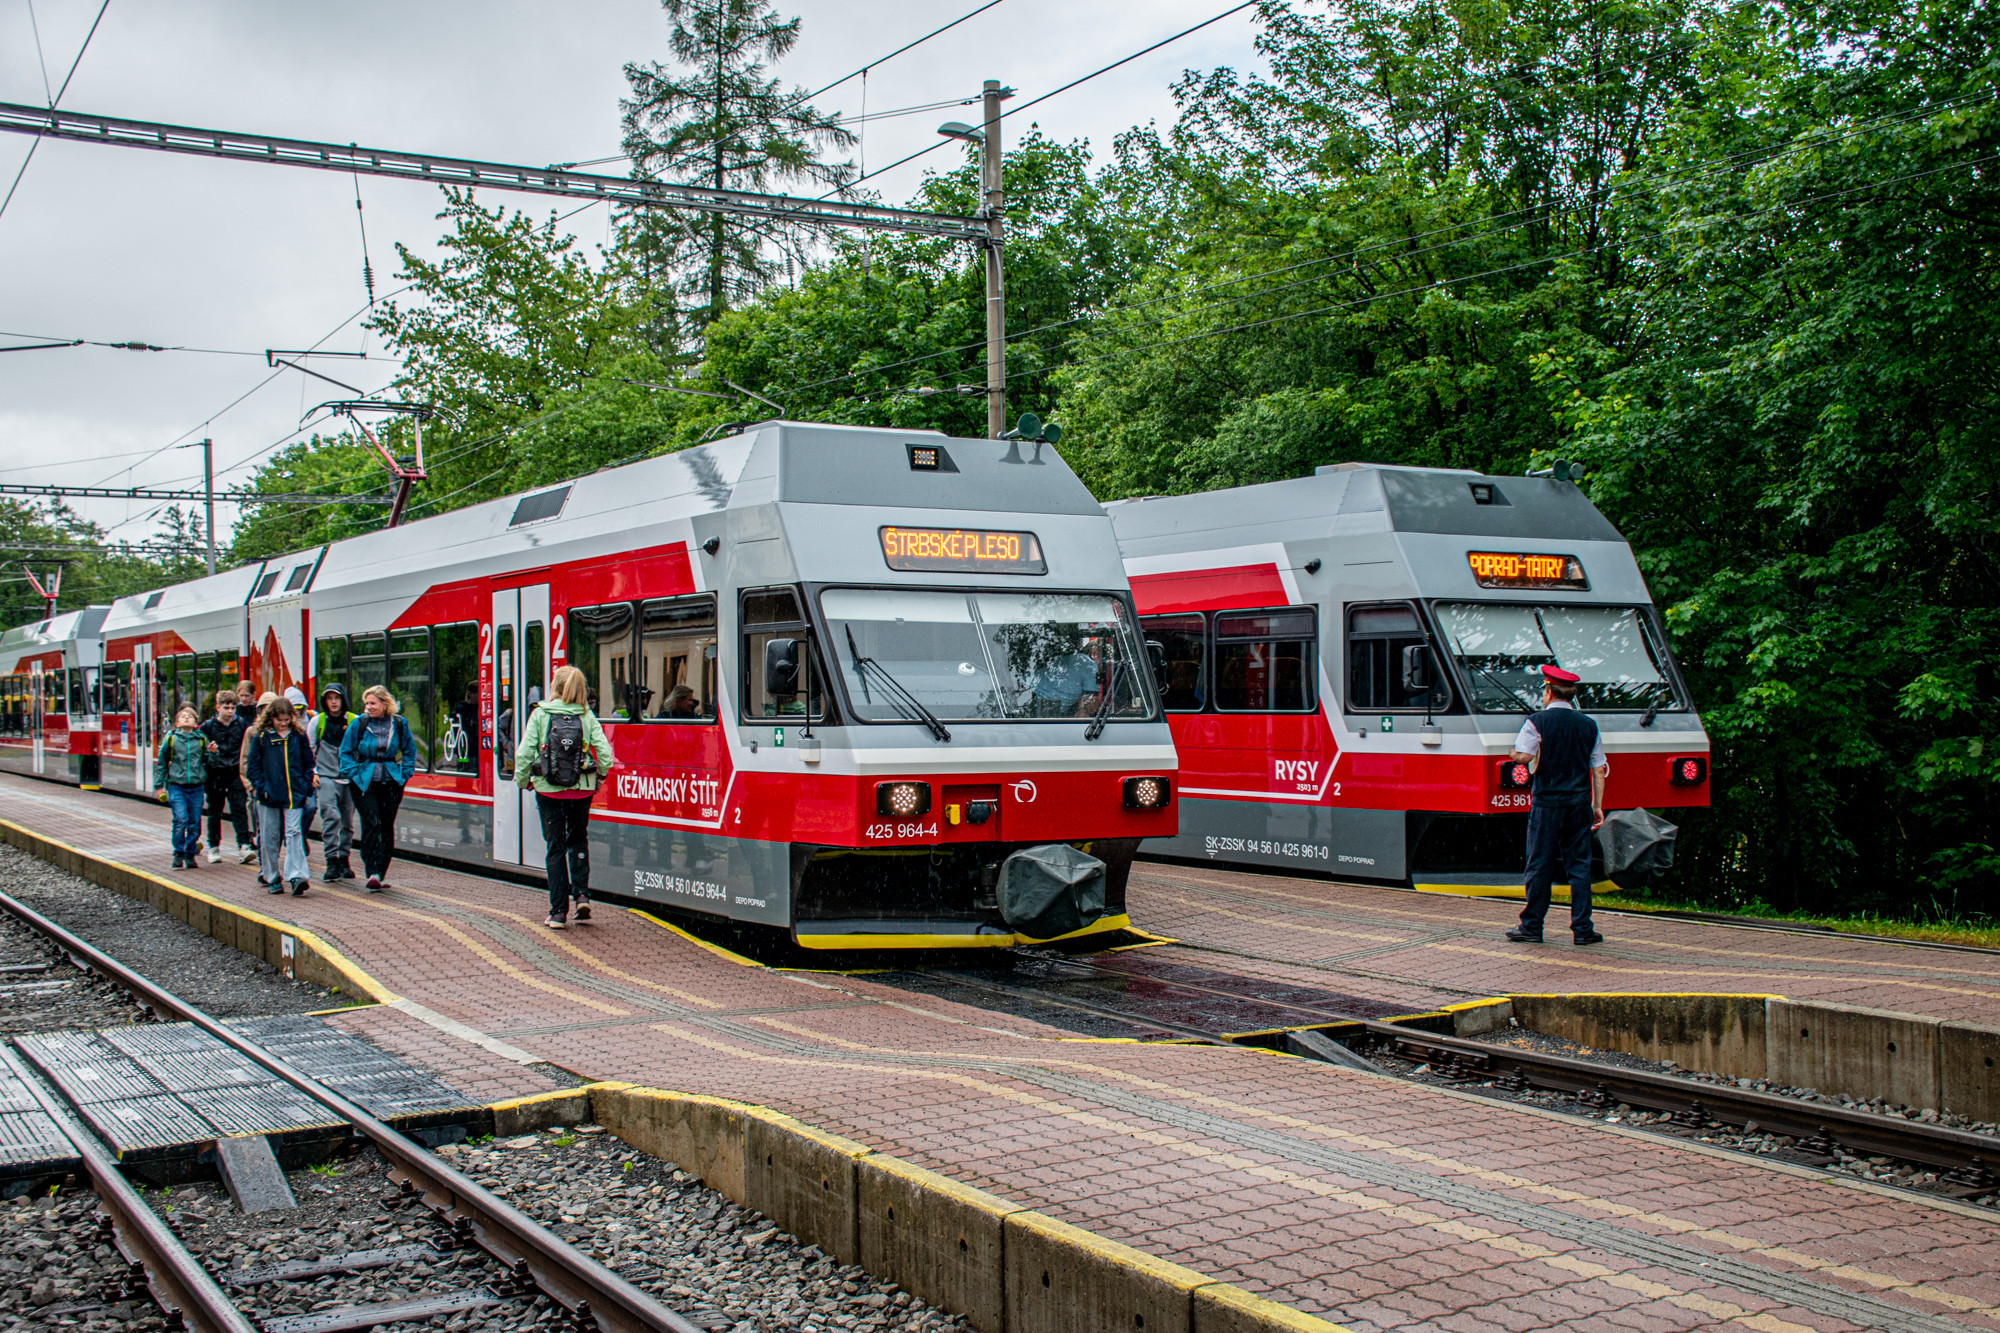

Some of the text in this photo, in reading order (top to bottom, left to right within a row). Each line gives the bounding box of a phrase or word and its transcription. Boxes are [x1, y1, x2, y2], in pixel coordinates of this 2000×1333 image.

[885, 527, 1019, 560] ŠTRBSKÉ PLESO
[1469, 554, 1563, 578] POPRAD-TATRY
[481, 623, 492, 664] 2
[552, 614, 565, 659] 2
[1275, 760, 1319, 781] RYSY
[617, 770, 718, 805] KEŽMARSKÝ ŠTÍT
[1296, 783, 1311, 792] 2503
[1333, 782, 1341, 796] 2
[1491, 794, 1531, 807] 425 961
[734, 807, 741, 824] 2
[865, 822, 938, 838] 425 964-4
[1206, 835, 1328, 859] SK-ZSSK 94 56 0 425 961-0
[1338, 854, 1375, 866] DEPO POPRAD
[634, 870, 727, 901] SK-ZSSK 94 56 0 425 964-4
[735, 896, 766, 908] DEPO POPRAD
